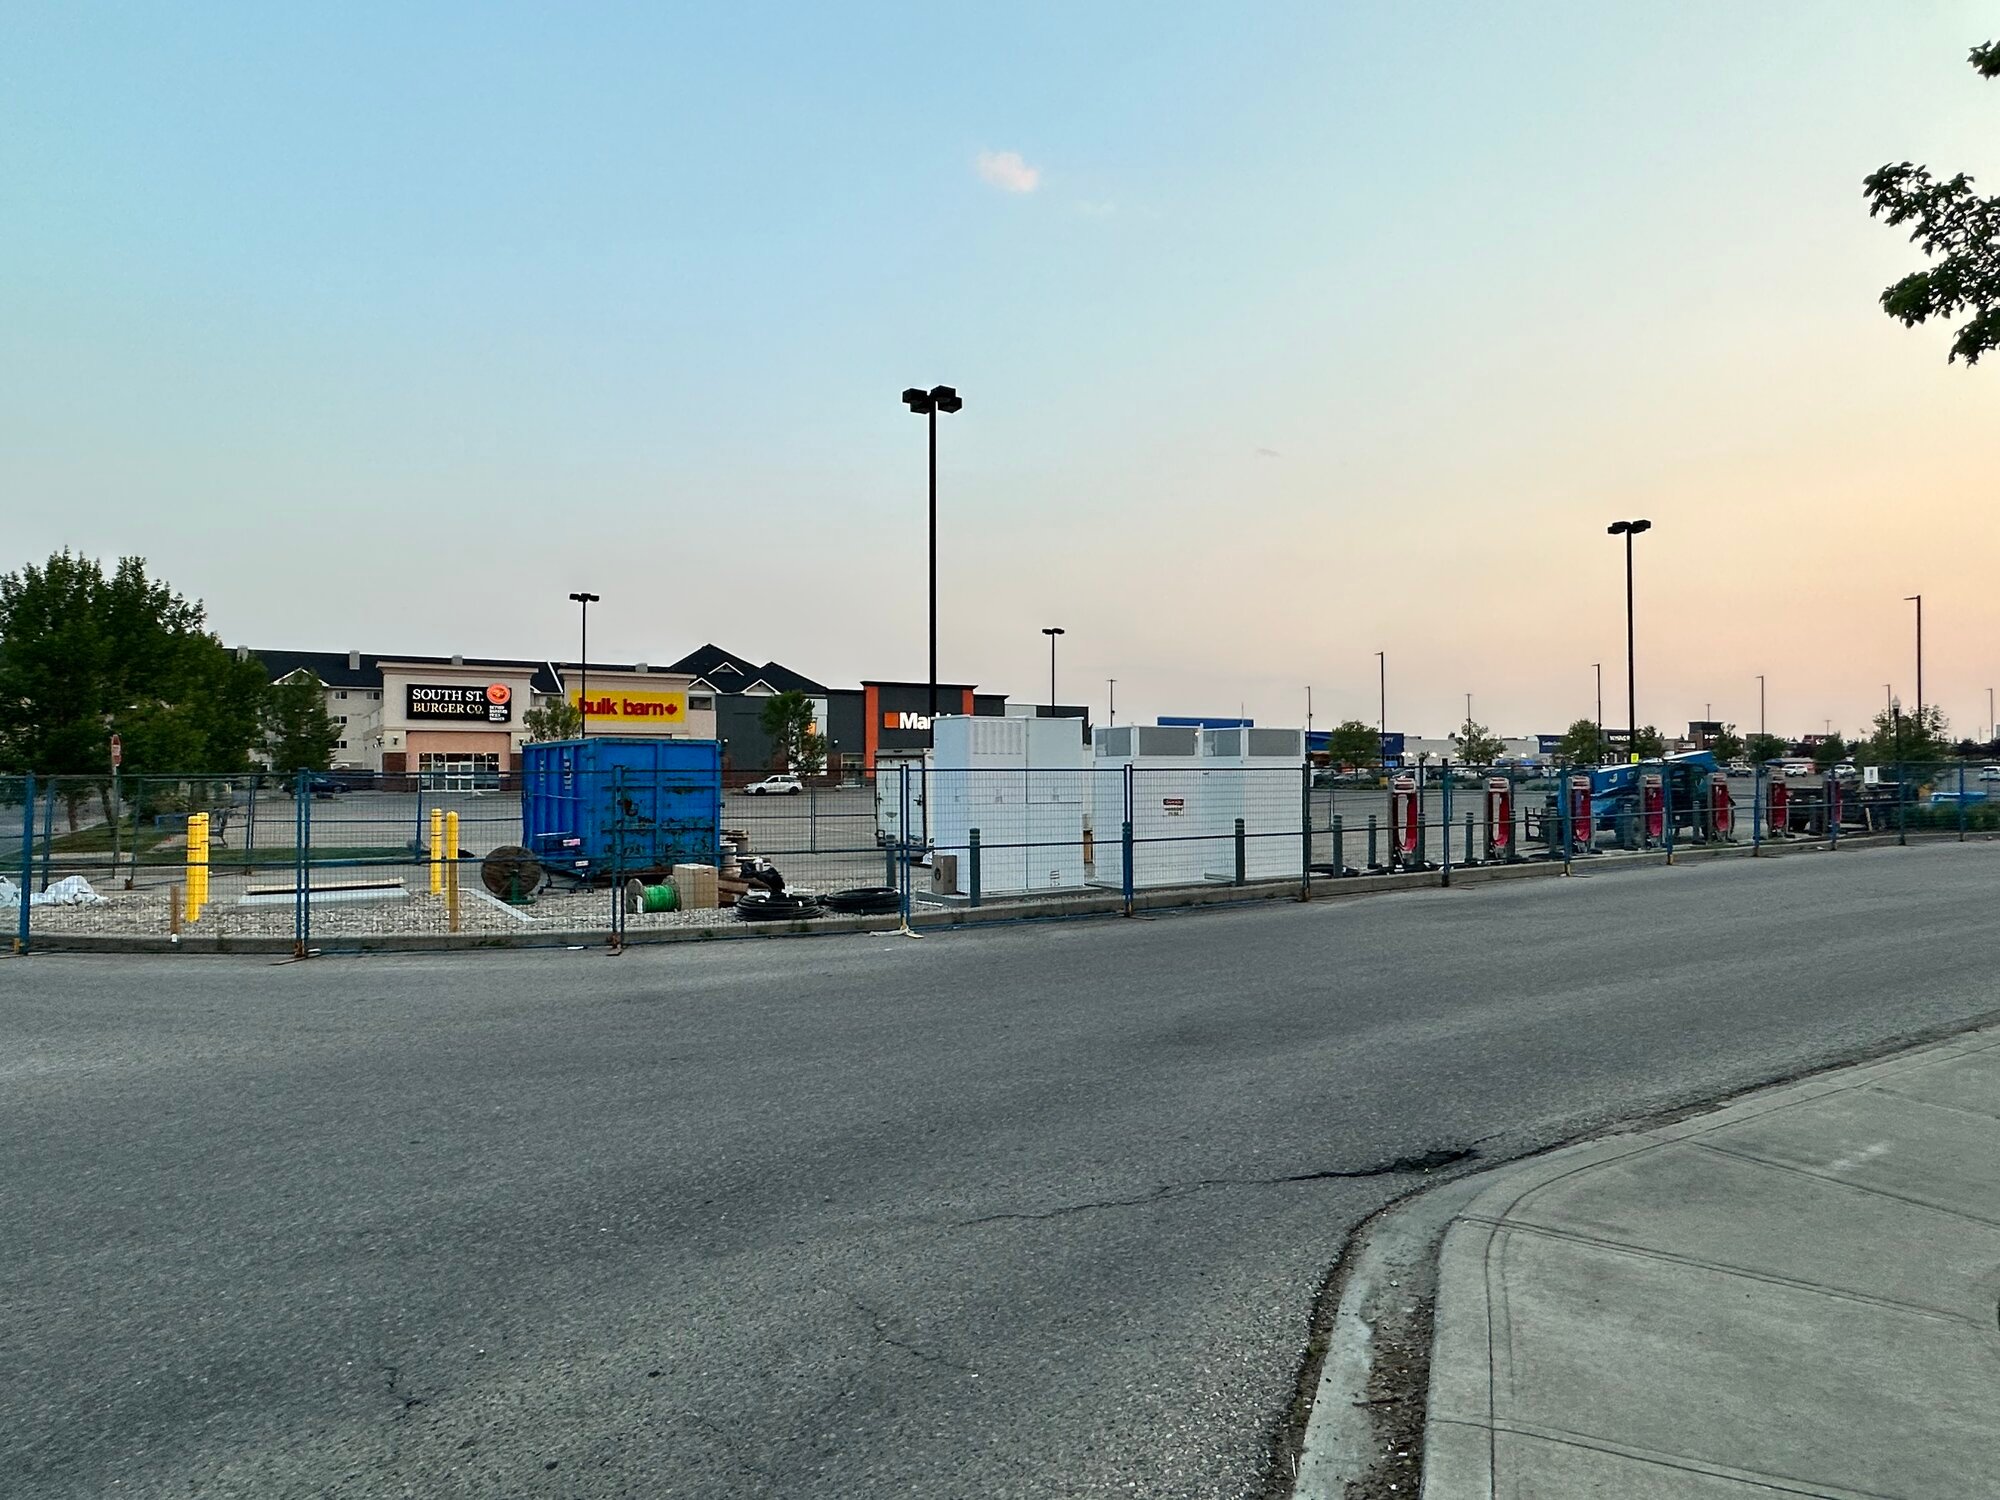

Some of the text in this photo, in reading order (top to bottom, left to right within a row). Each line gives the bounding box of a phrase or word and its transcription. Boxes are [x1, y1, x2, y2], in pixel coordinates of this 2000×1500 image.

[412, 688, 484, 702] SOUTH ST.
[413, 702, 465, 714] BURGER
[578, 697, 664, 716] bulk barn
